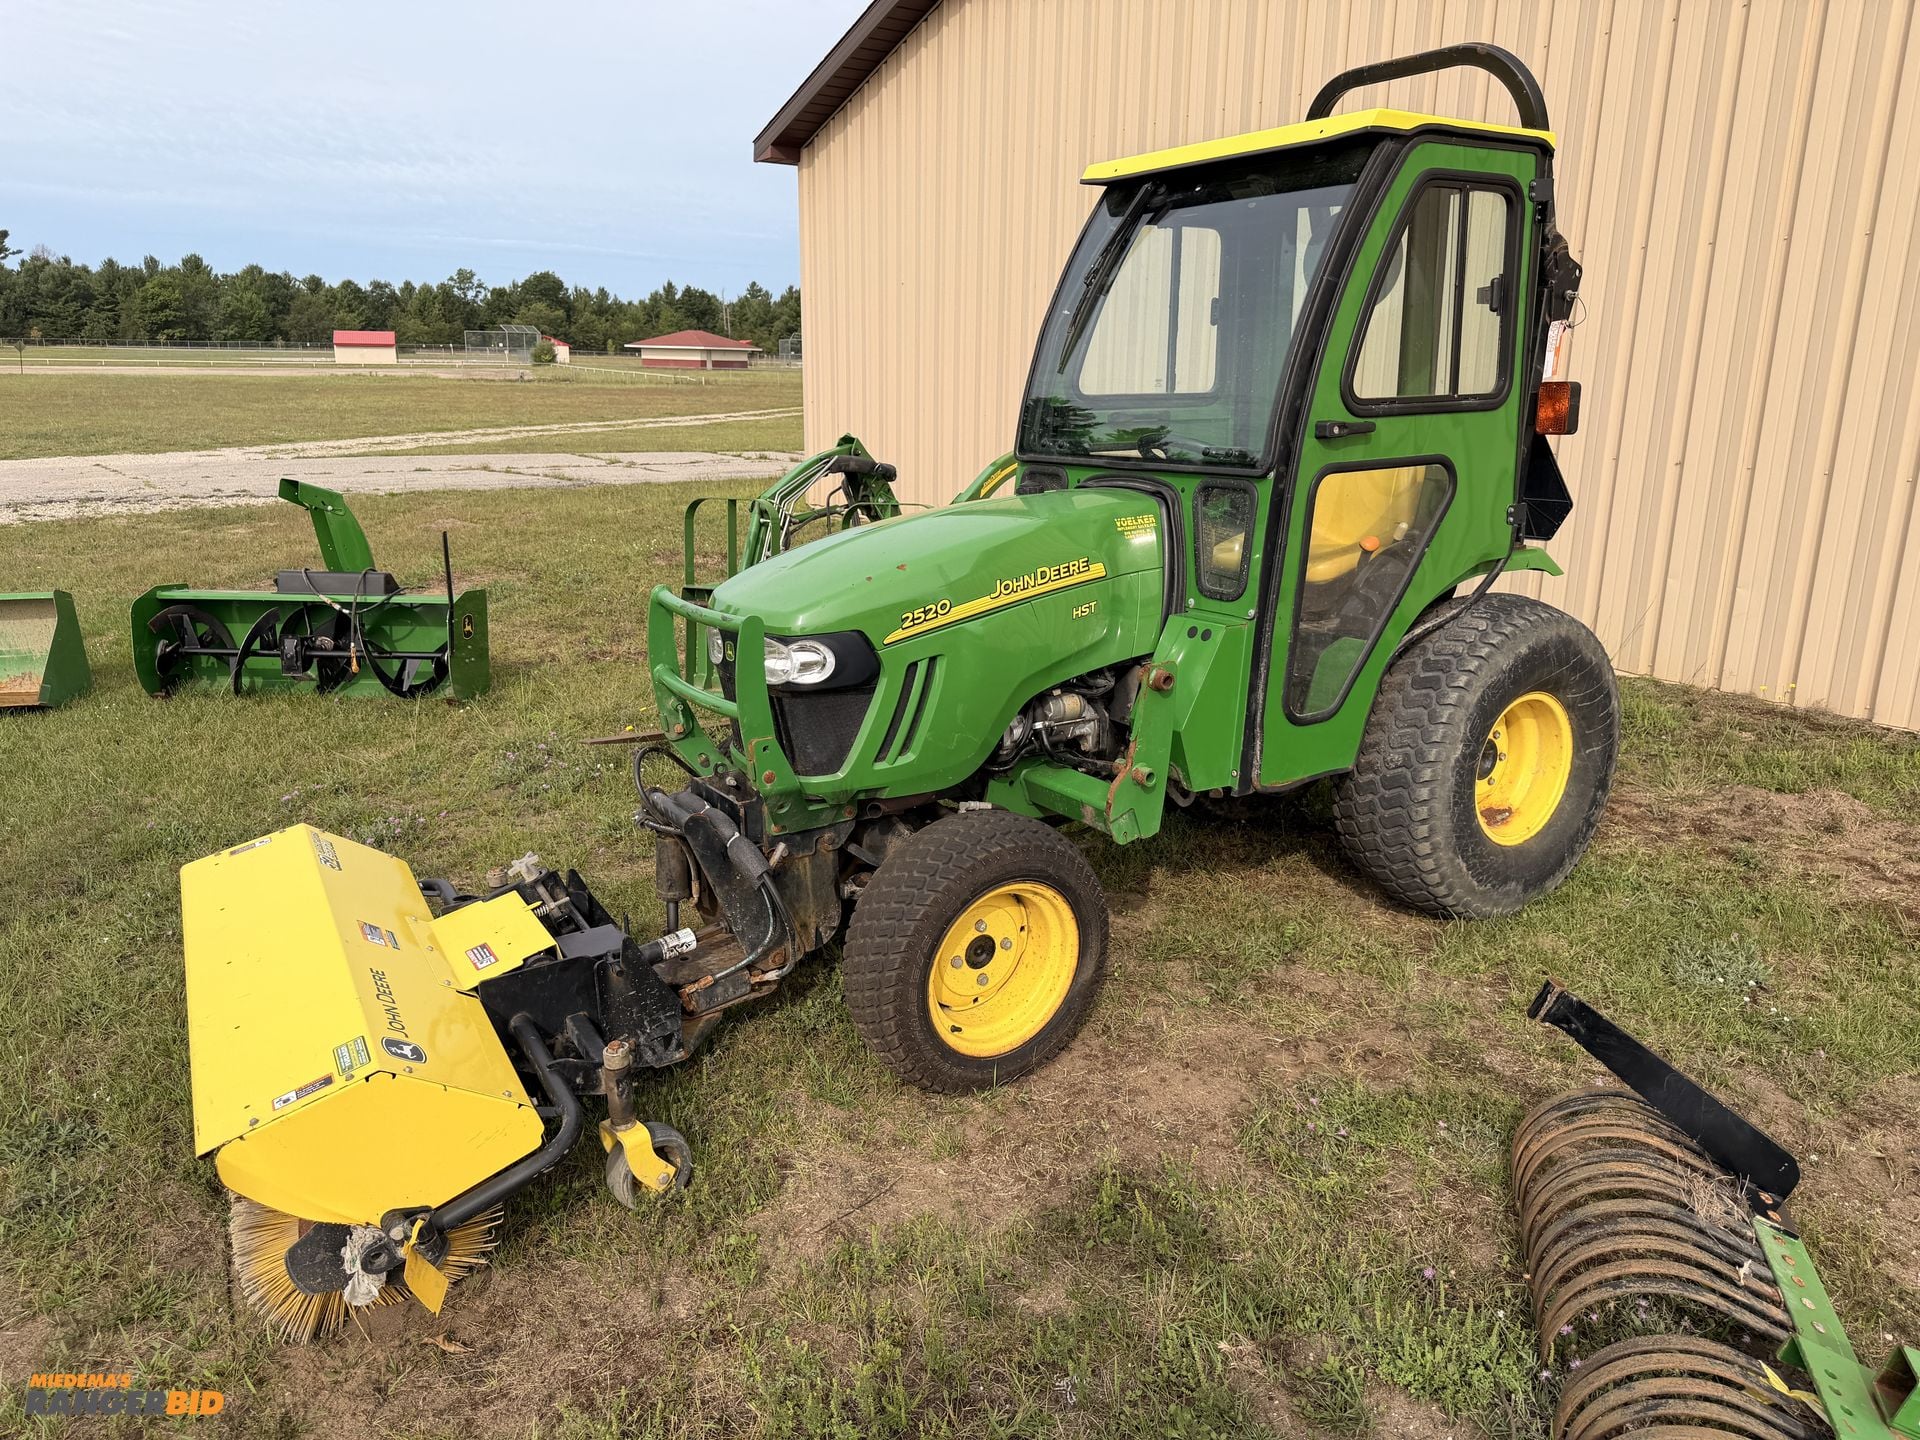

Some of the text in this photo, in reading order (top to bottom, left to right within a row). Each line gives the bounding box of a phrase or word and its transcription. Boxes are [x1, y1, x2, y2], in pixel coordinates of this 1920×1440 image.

[1114, 514, 1156, 527] VOELKER
[989, 556, 1090, 600] JOHN DEERE
[901, 598, 952, 630] 2520
[1072, 601, 1098, 620] HST
[369, 967, 396, 1005] DEERE
[382, 1003, 409, 1039] JOHN
